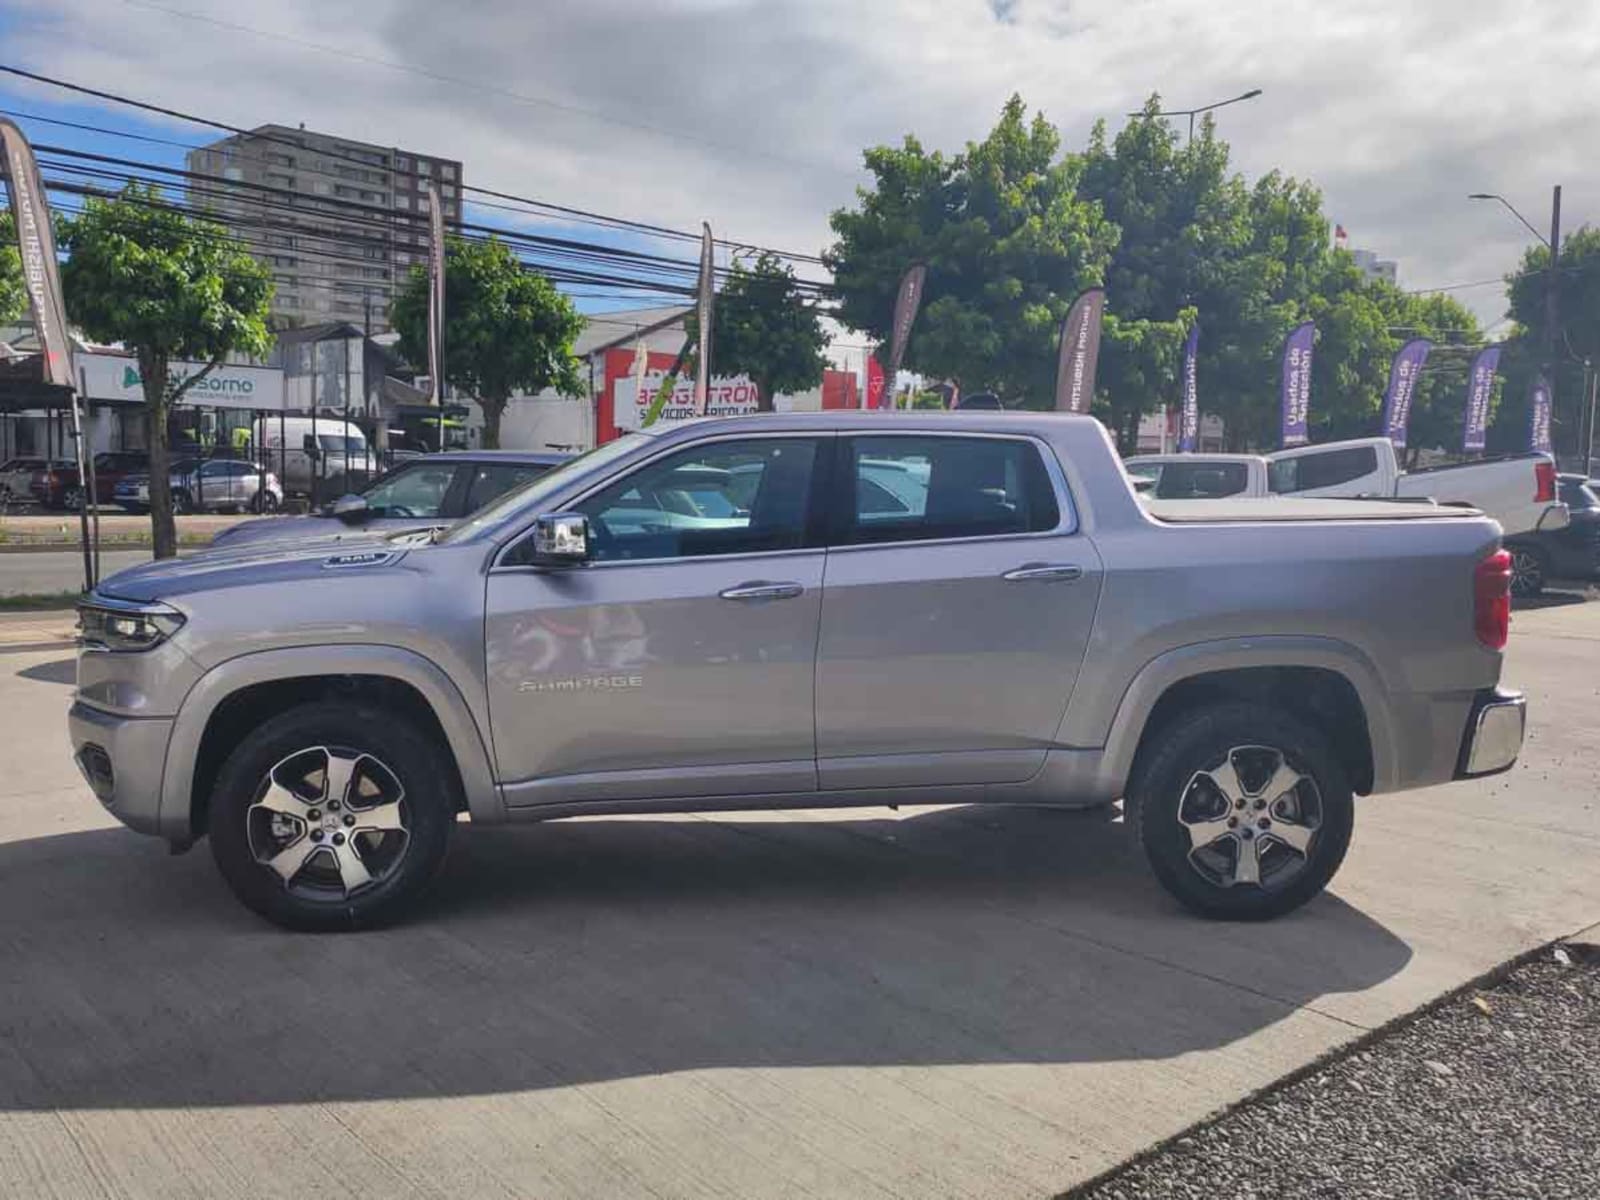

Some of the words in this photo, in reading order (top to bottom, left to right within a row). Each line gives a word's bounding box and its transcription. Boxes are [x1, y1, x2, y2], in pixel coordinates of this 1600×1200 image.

[637, 380, 759, 405] BERGTRÖ
[1070, 351, 1086, 411] MITSUBISHI
[1287, 370, 1299, 425] Usados
[639, 407, 694, 420] SVICIOS
